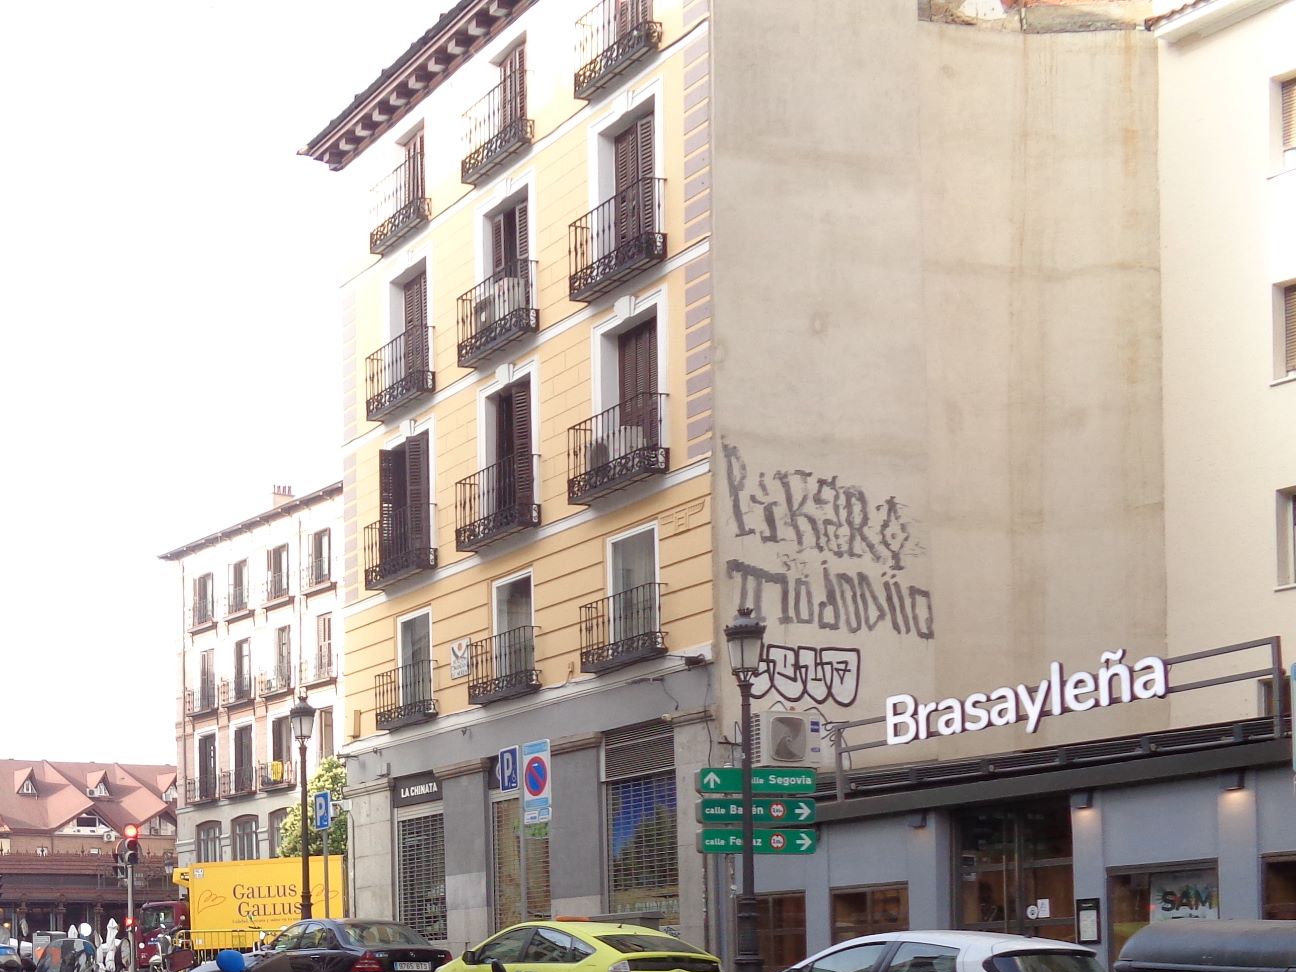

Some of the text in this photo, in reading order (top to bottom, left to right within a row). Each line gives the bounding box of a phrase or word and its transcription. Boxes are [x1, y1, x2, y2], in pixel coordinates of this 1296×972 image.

[885, 648, 1168, 746] Brasayleña
[504, 752, 513, 786] P
[769, 775, 812, 786] Segovia
[401, 782, 438, 798] LA CHINATA
[316, 796, 326, 826] P
[705, 806, 726, 814] calle
[729, 805, 764, 814] Baén
[705, 836, 762, 846] calle Feaz
